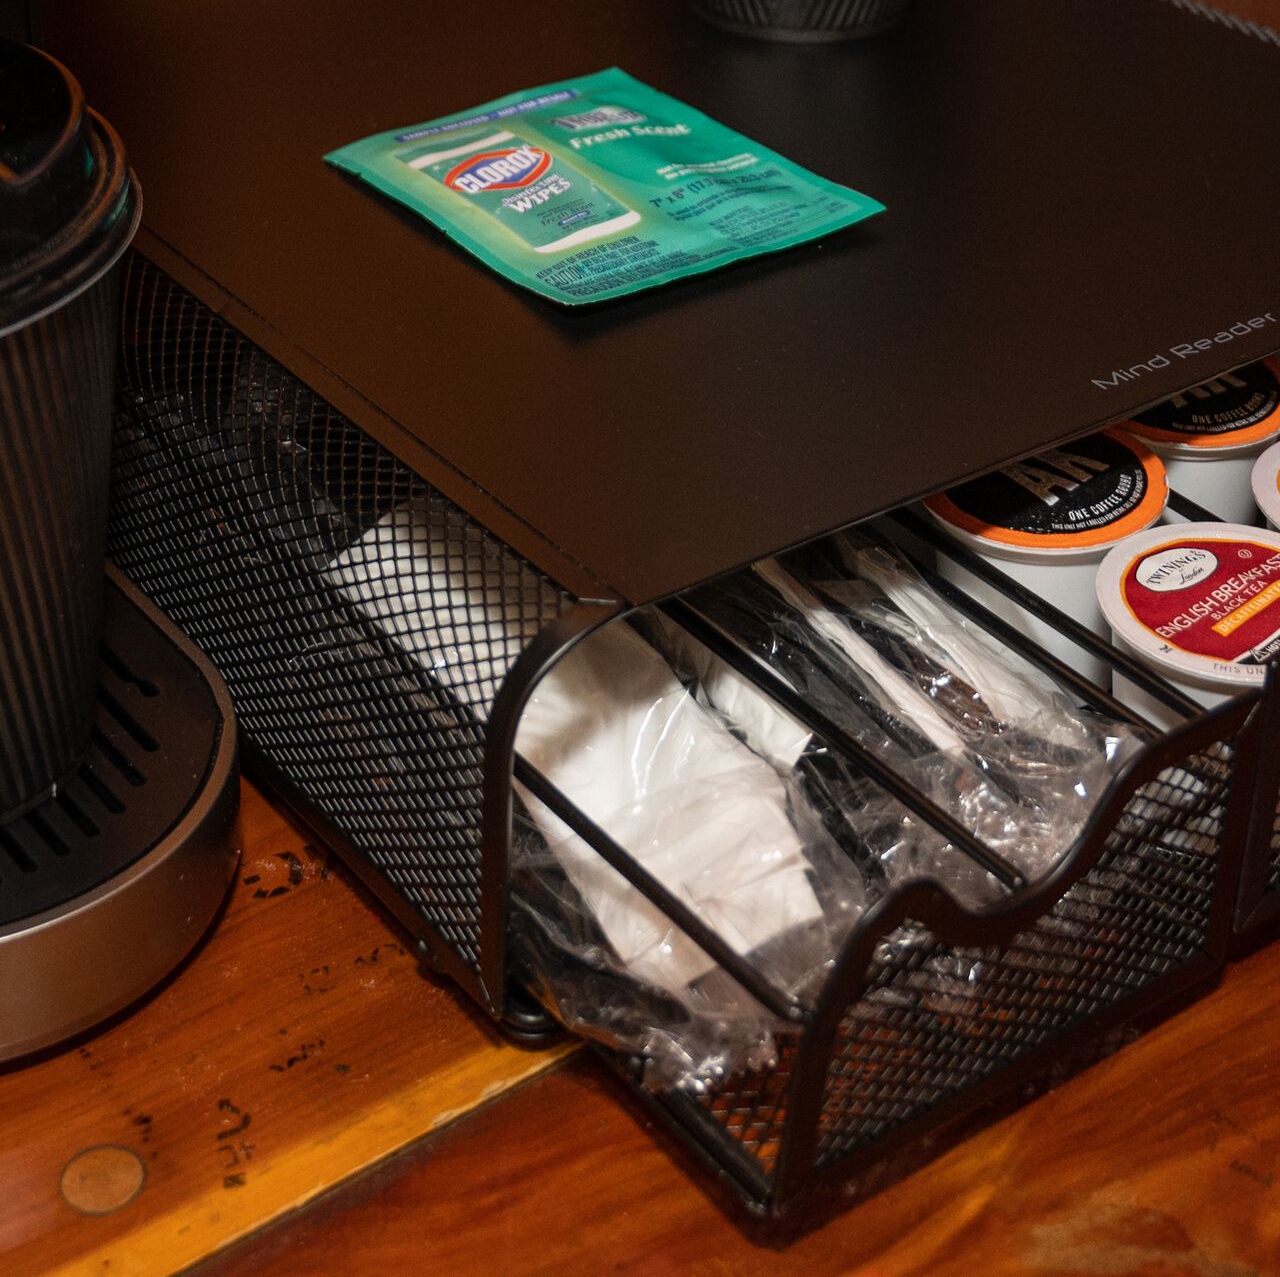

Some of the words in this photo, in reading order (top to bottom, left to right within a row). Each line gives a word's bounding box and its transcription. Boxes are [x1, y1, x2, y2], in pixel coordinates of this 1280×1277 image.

[570, 128, 630, 149] Fresh
[631, 124, 691, 136] Scent
[454, 143, 542, 194] CLOROX
[509, 177, 571, 213] WIPES
[1091, 354, 1170, 390] Mind
[1170, 313, 1276, 359] Reader
[1068, 508, 1090, 521] ONE
[1090, 493, 1123, 515] COFFEE
[1155, 596, 1219, 638] ENGLISH
[1210, 595, 1247, 620] BLACK
[1243, 580, 1268, 598] TEA
[1213, 663, 1241, 673] THIS
[1246, 666, 1264, 675] UN
